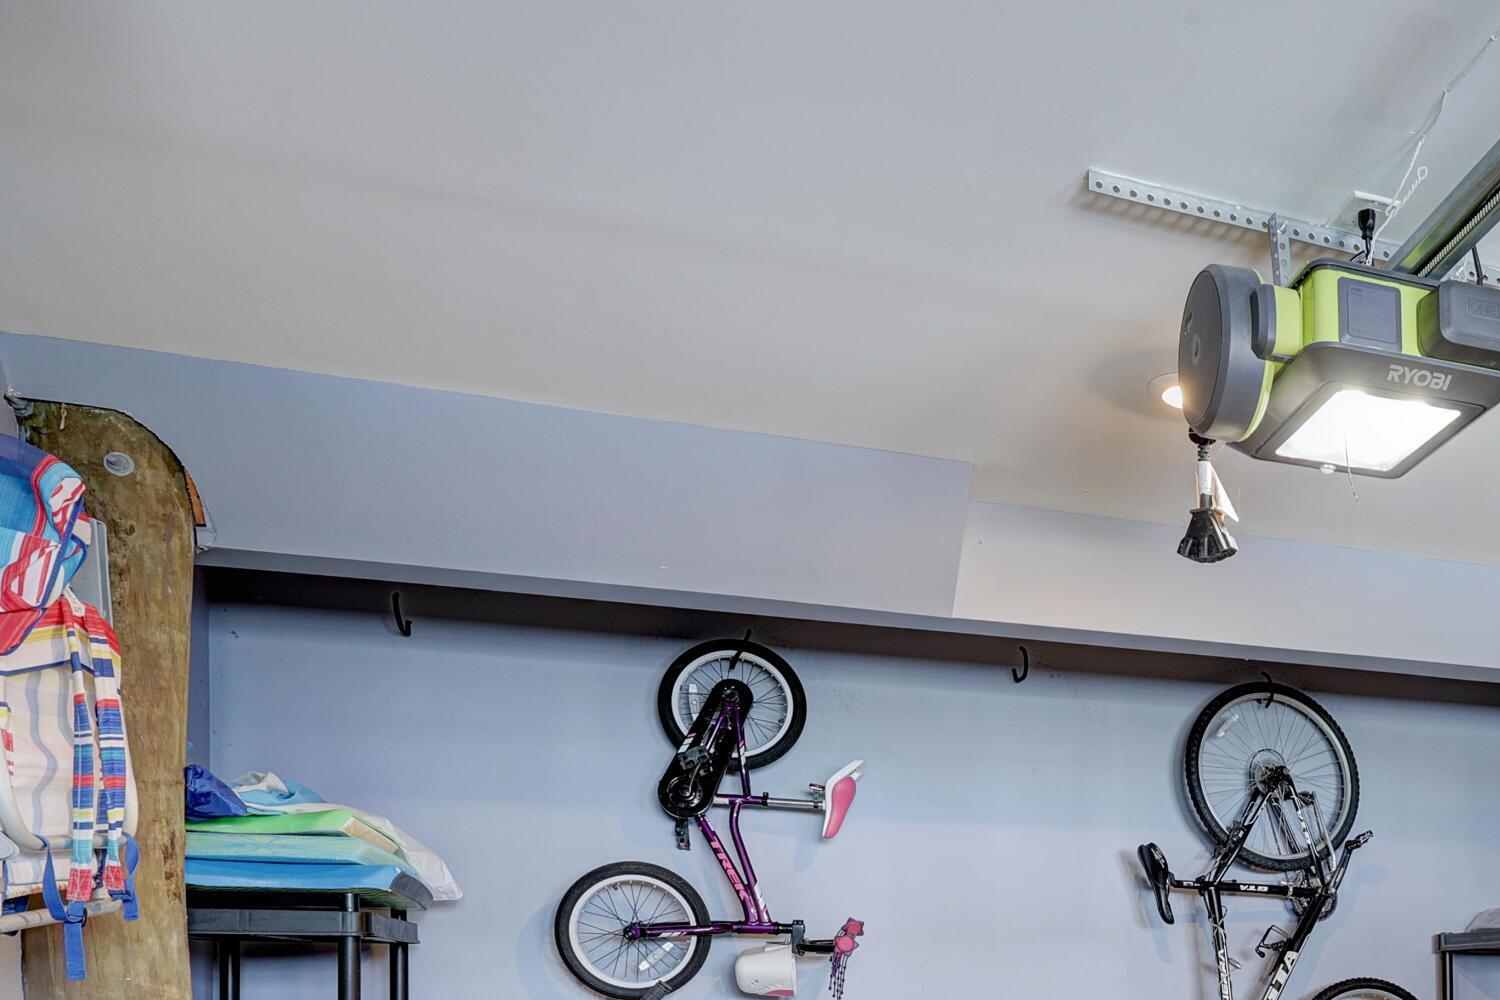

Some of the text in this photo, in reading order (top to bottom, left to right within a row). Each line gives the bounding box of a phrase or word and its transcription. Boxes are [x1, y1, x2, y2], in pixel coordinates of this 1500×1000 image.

[1387, 364, 1452, 391] RYOBI
[710, 835, 749, 901] TREK
[1240, 884, 1269, 892] GTA
